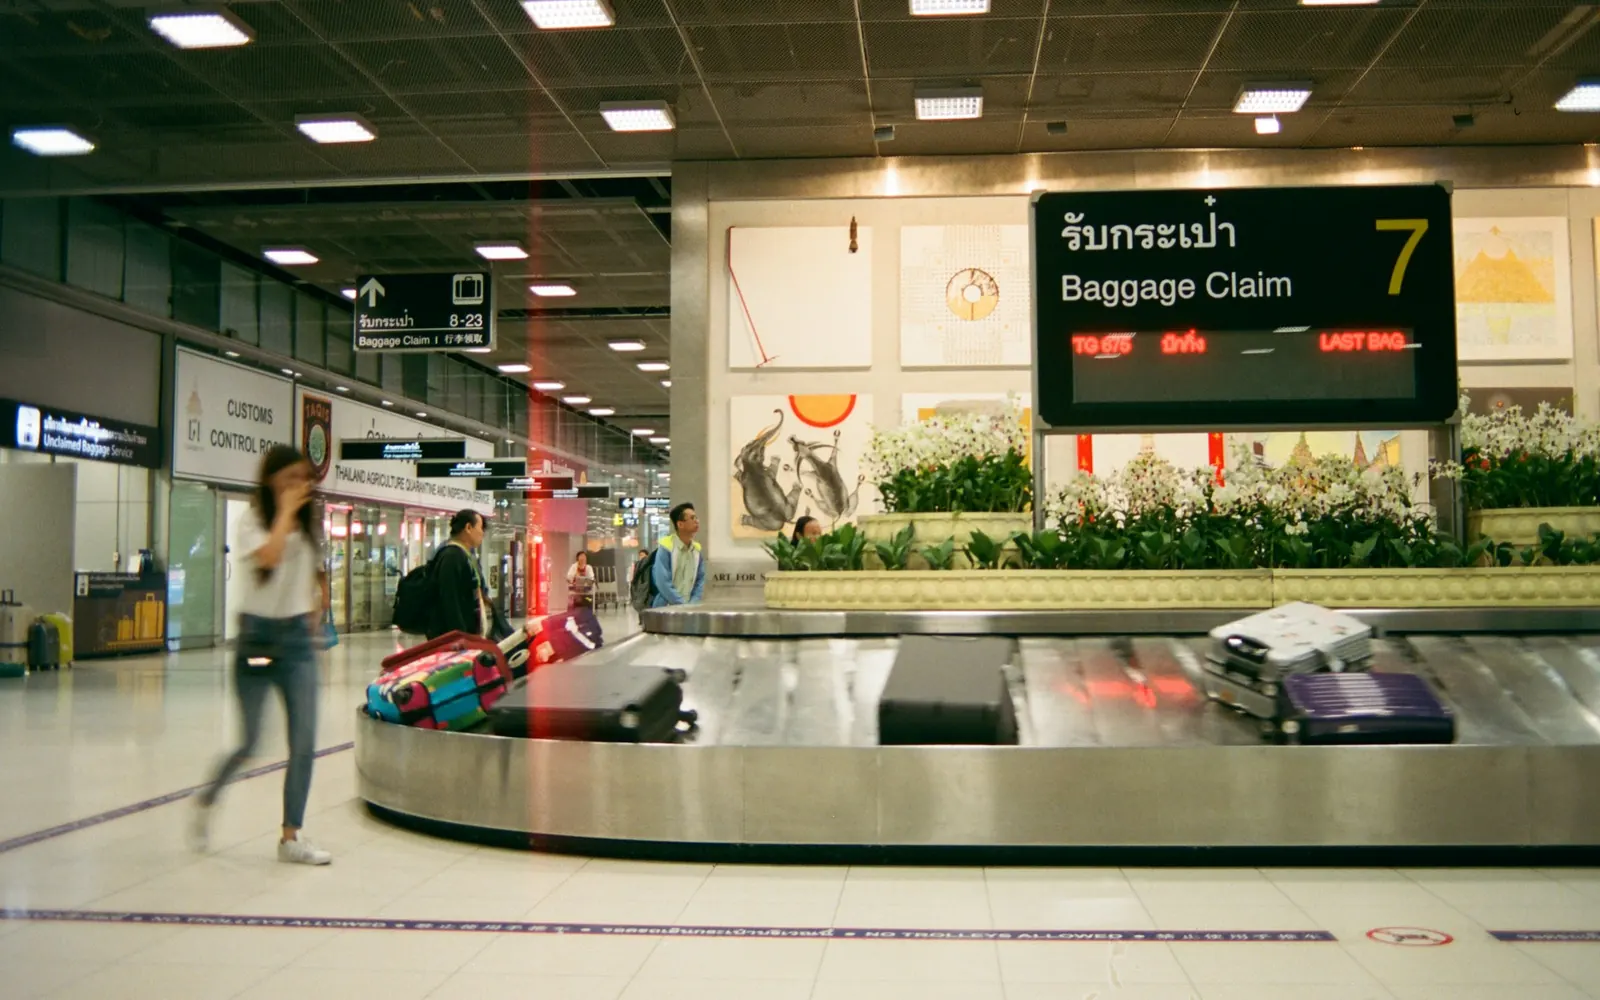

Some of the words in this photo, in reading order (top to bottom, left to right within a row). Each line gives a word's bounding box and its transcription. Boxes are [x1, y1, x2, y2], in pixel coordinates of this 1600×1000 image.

[1061, 195, 1237, 251] รับกระเป๋า
[1375, 218, 1429, 295] 7
[1061, 274, 1196, 307] Baggage
[1205, 271, 1292, 299] Claim
[449, 314, 483, 327] 8-23
[359, 336, 401, 348] Baggage
[403, 335, 430, 345] Claim
[1072, 335, 1099, 354] TG
[1320, 332, 1365, 352] LAST
[1367, 331, 1406, 352] BAG
[227, 399, 273, 425] CUSTOMS
[43, 433, 81, 453] Unclaimed
[82, 439, 111, 458] Baggage
[111, 444, 134, 458] Service
[210, 429, 257, 454] CONTROL
[335, 464, 366, 484] THAILAND
[366, 470, 405, 490] AGRICULTURE
[405, 477, 437, 496] QUARANTINE
[713, 573, 731, 581] ART
[736, 573, 756, 581] FOR
